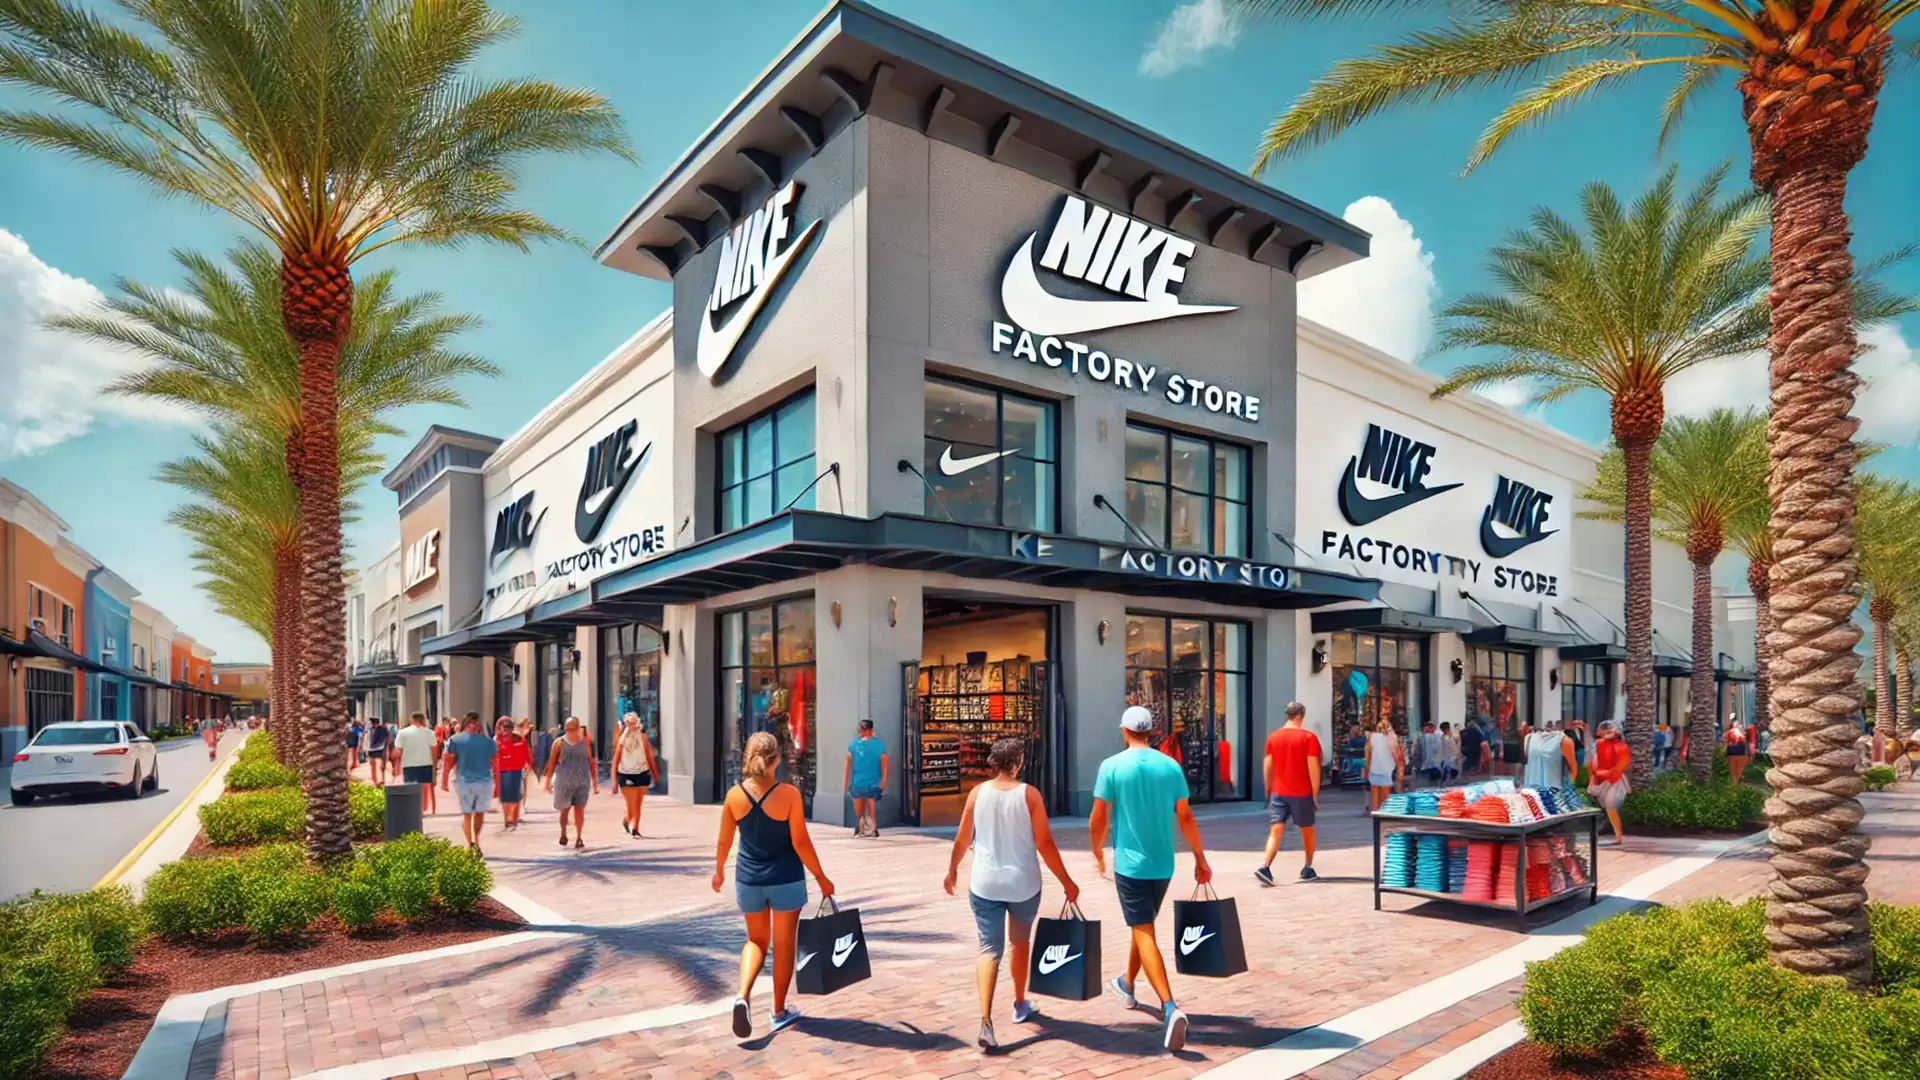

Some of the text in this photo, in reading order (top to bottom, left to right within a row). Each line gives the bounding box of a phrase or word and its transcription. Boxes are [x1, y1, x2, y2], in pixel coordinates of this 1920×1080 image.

[710, 180, 794, 311] NIKE
[1040, 195, 1196, 303] NIKE
[992, 321, 1260, 421] FACTORY STORE
[1357, 423, 1437, 494] NIKE
[1490, 472, 1553, 537] NIKE
